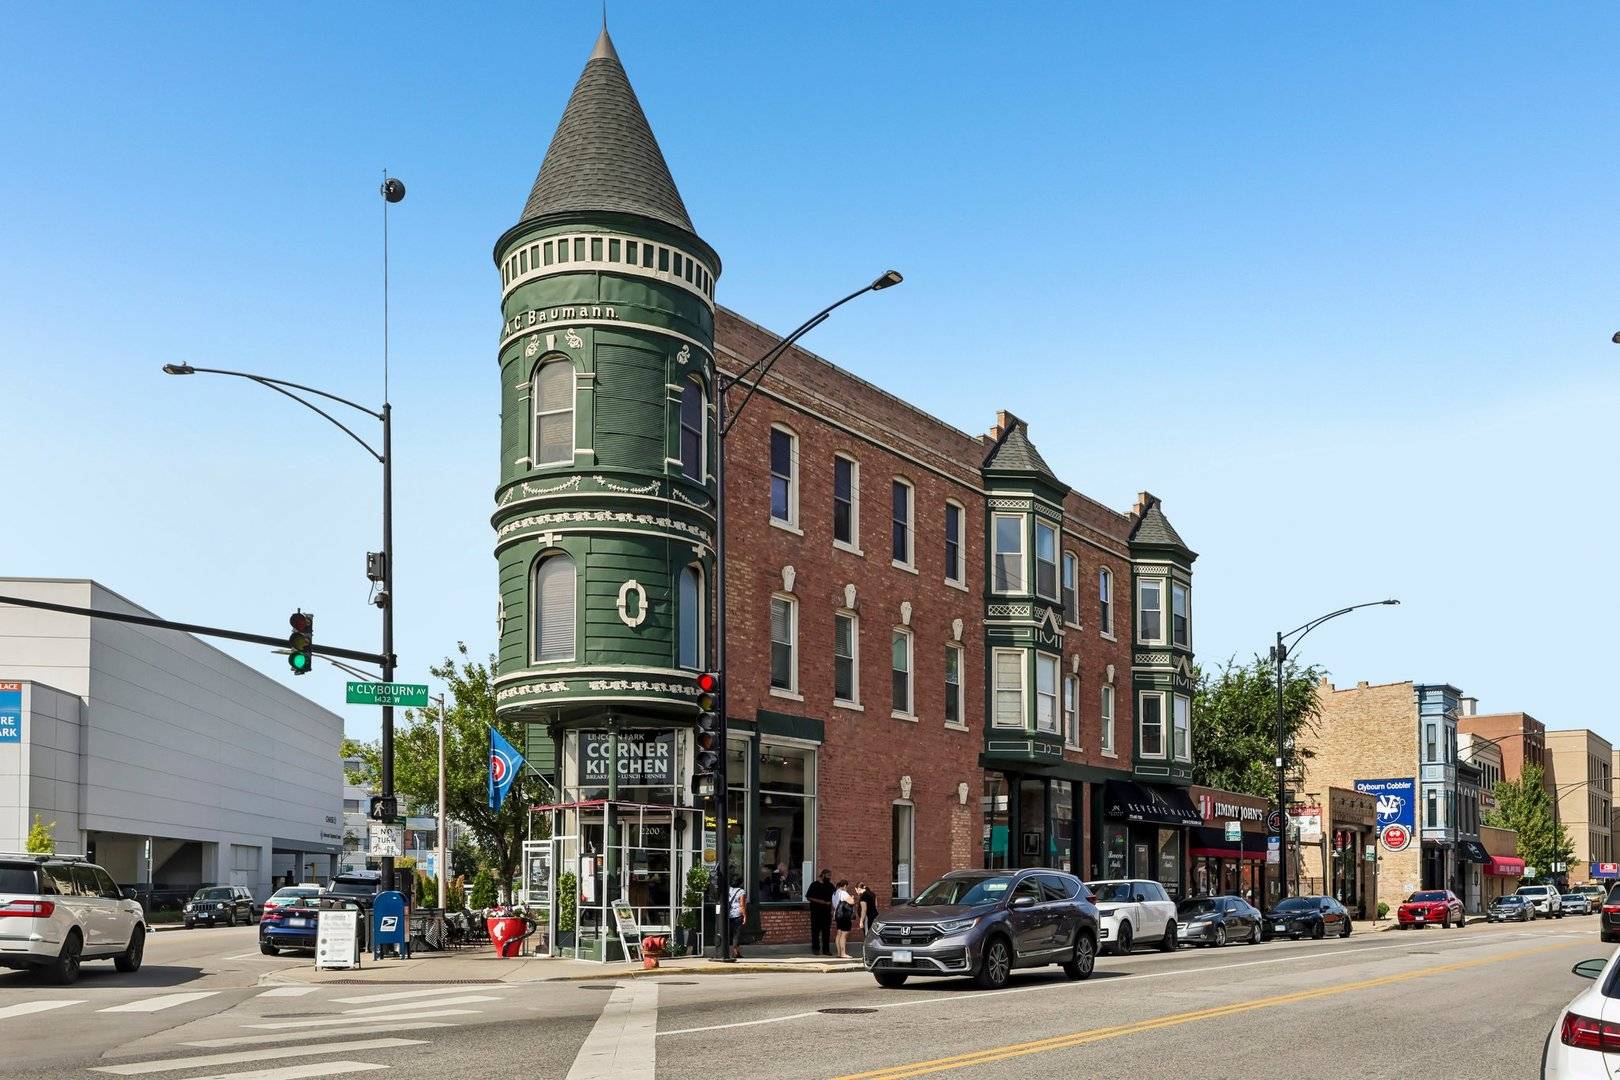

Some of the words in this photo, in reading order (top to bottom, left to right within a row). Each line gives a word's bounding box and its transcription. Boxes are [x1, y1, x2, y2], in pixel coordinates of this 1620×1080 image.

[356, 684, 414, 696] CLYBOURN
[394, 696, 401, 704] W
[587, 733, 623, 741] LINCN
[586, 742, 669, 758] CORNER
[1357, 783, 1385, 791] Clybourn
[1386, 782, 1412, 790] Cobbler
[1128, 803, 1168, 815] REVERIE
[1170, 808, 1198, 818] NAILS
[1214, 802, 1240, 818] JIMMY
[1240, 806, 1263, 821] JOHN'S
[641, 827, 660, 835] 2200
